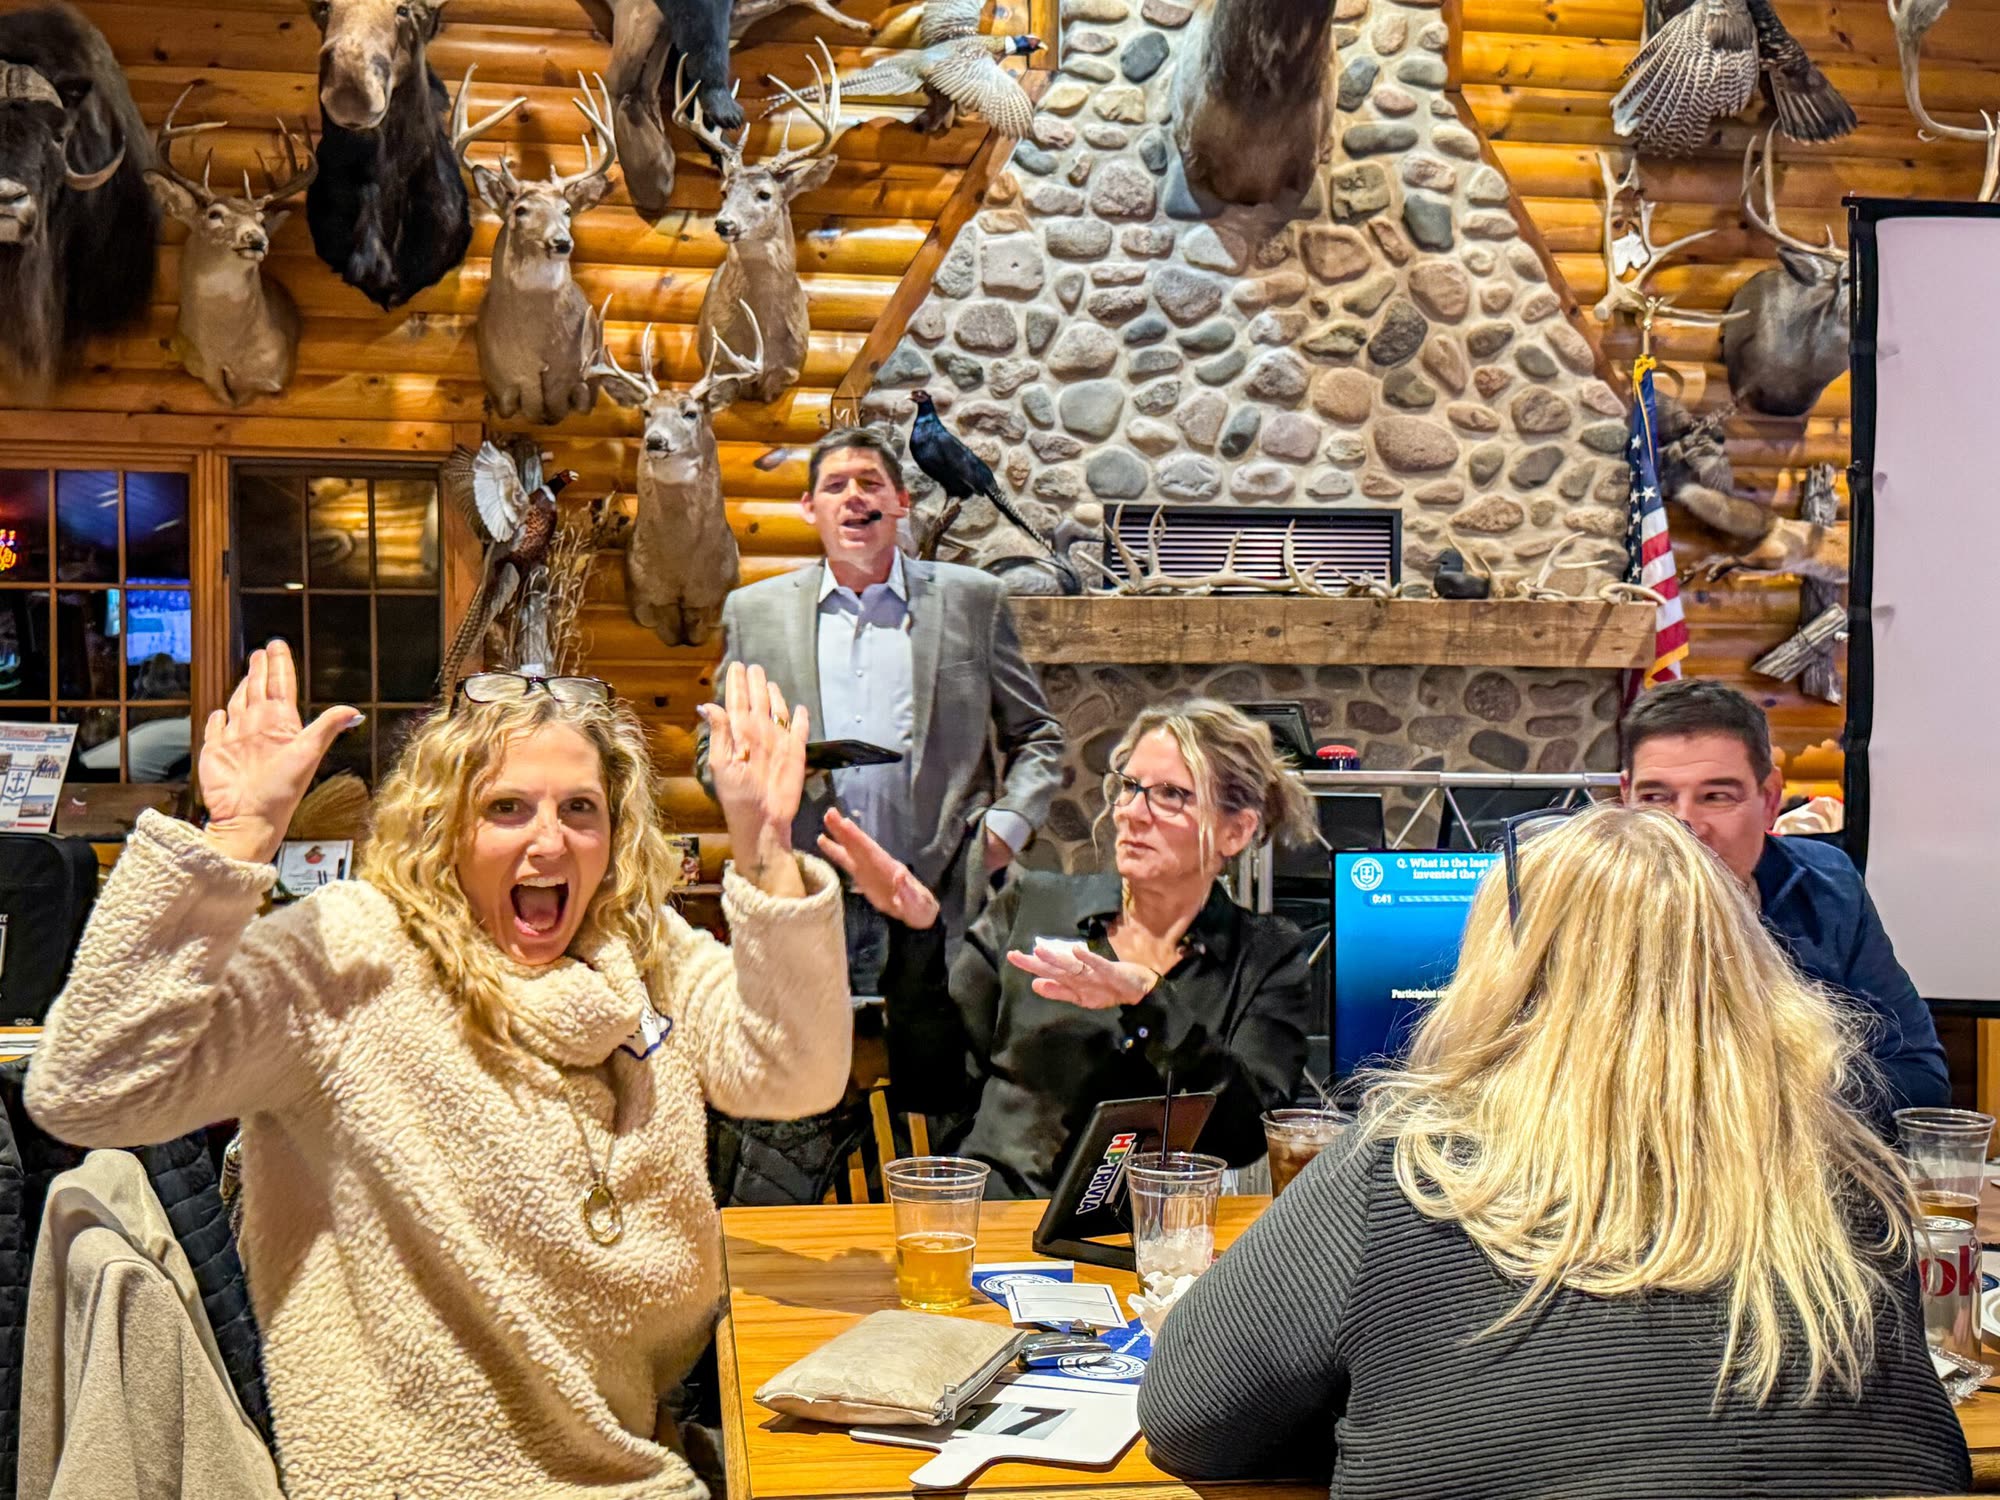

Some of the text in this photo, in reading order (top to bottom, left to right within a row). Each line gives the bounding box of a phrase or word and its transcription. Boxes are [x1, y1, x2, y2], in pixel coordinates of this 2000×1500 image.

[1396, 858, 1408, 869] Q.
[1410, 857, 1438, 868] What
[1440, 858, 1449, 868] is
[1451, 858, 1468, 868] the
[1469, 857, 1488, 868] last
[1413, 869, 1458, 879] invented
[1459, 869, 1476, 879] the
[1391, 988, 1437, 1000] Participant
[1919, 1240, 1981, 1297] ok
[955, 1402, 1067, 1436] 17
